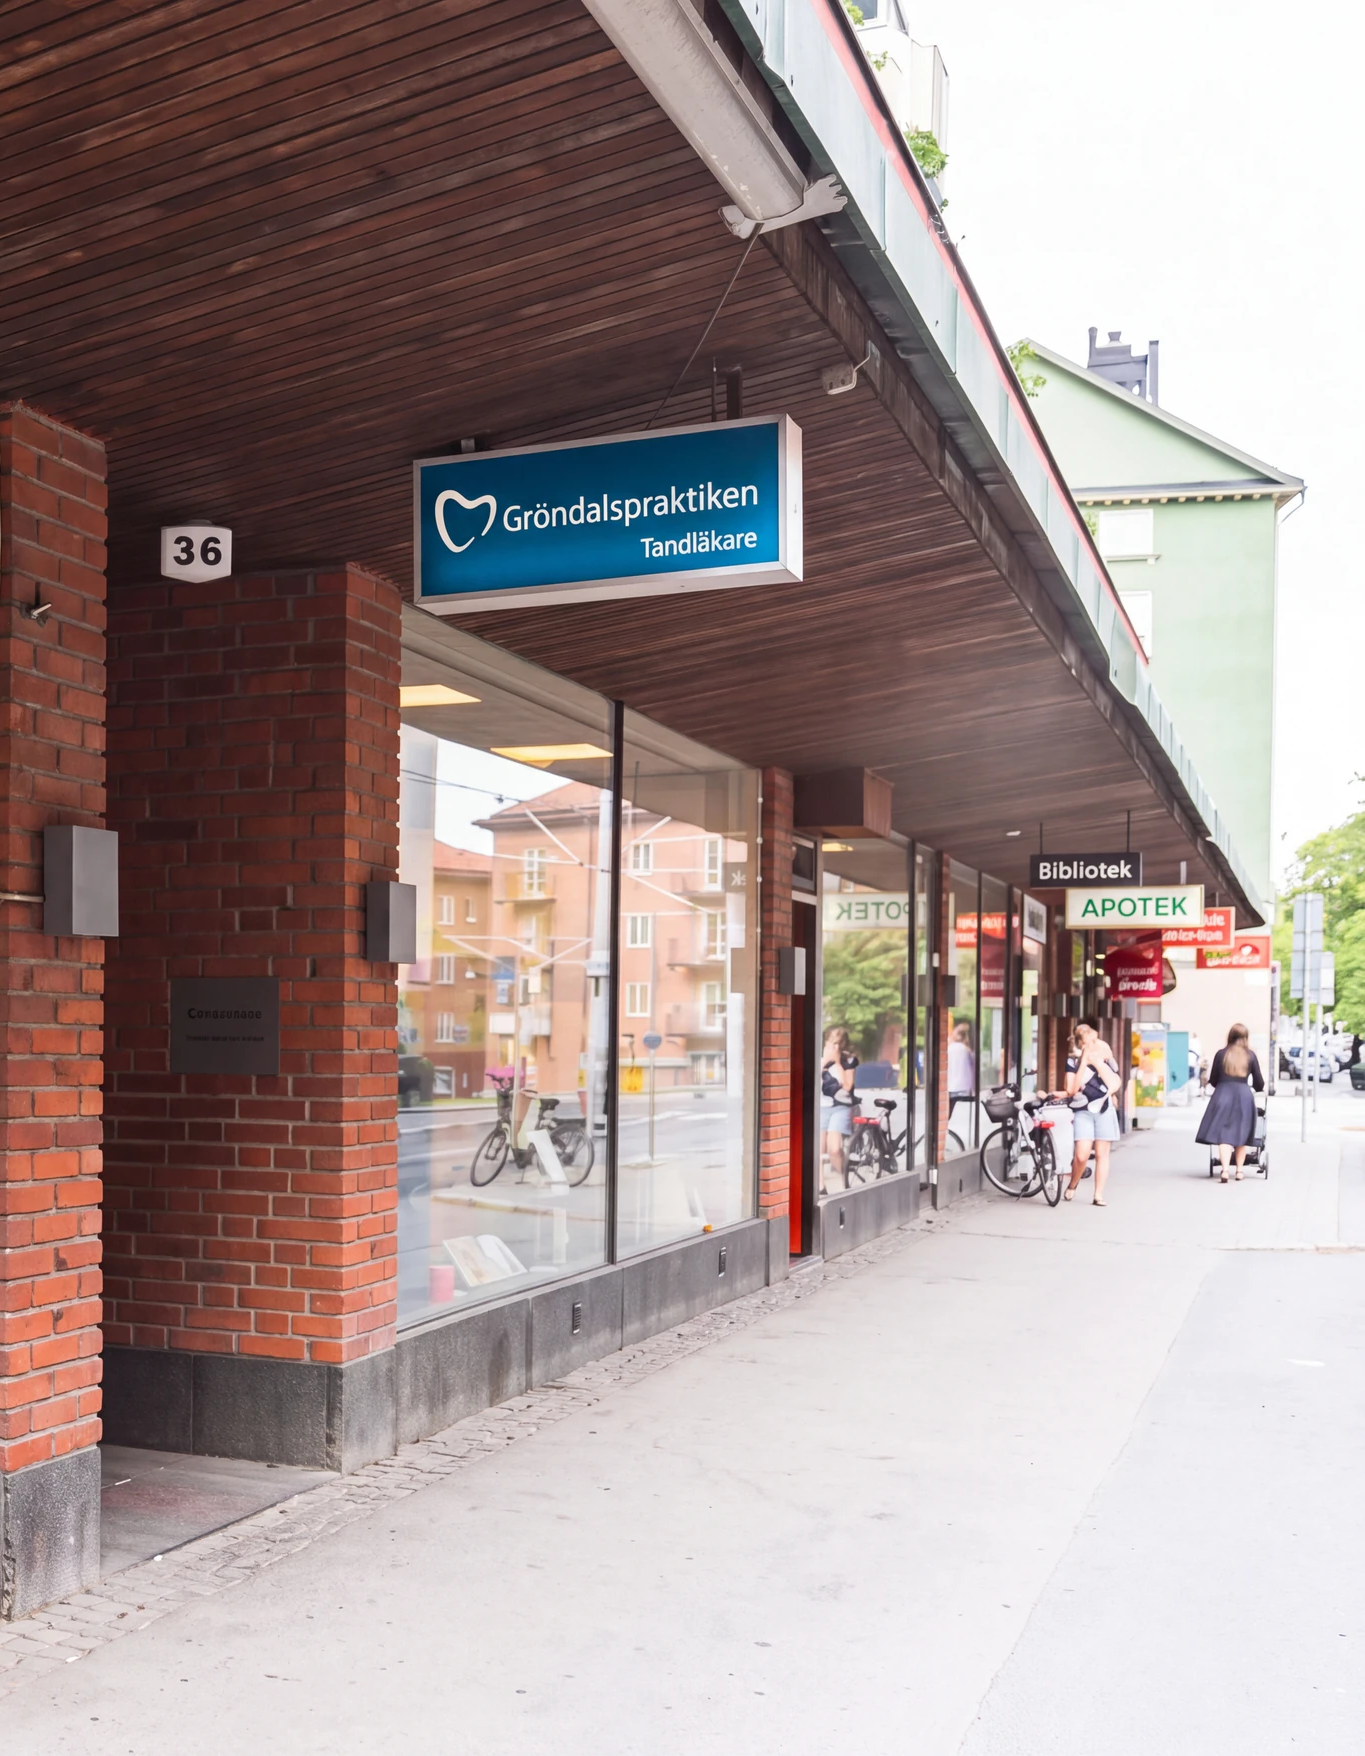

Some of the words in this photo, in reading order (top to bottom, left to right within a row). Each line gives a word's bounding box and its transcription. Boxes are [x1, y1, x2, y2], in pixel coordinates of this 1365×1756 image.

[502, 481, 759, 532] Gröndalspraktiken
[172, 535, 223, 567] 36
[640, 529, 758, 559] Tandläkare
[1039, 861, 1132, 881] Bibliotek
[1081, 896, 1188, 918] APOTEK
